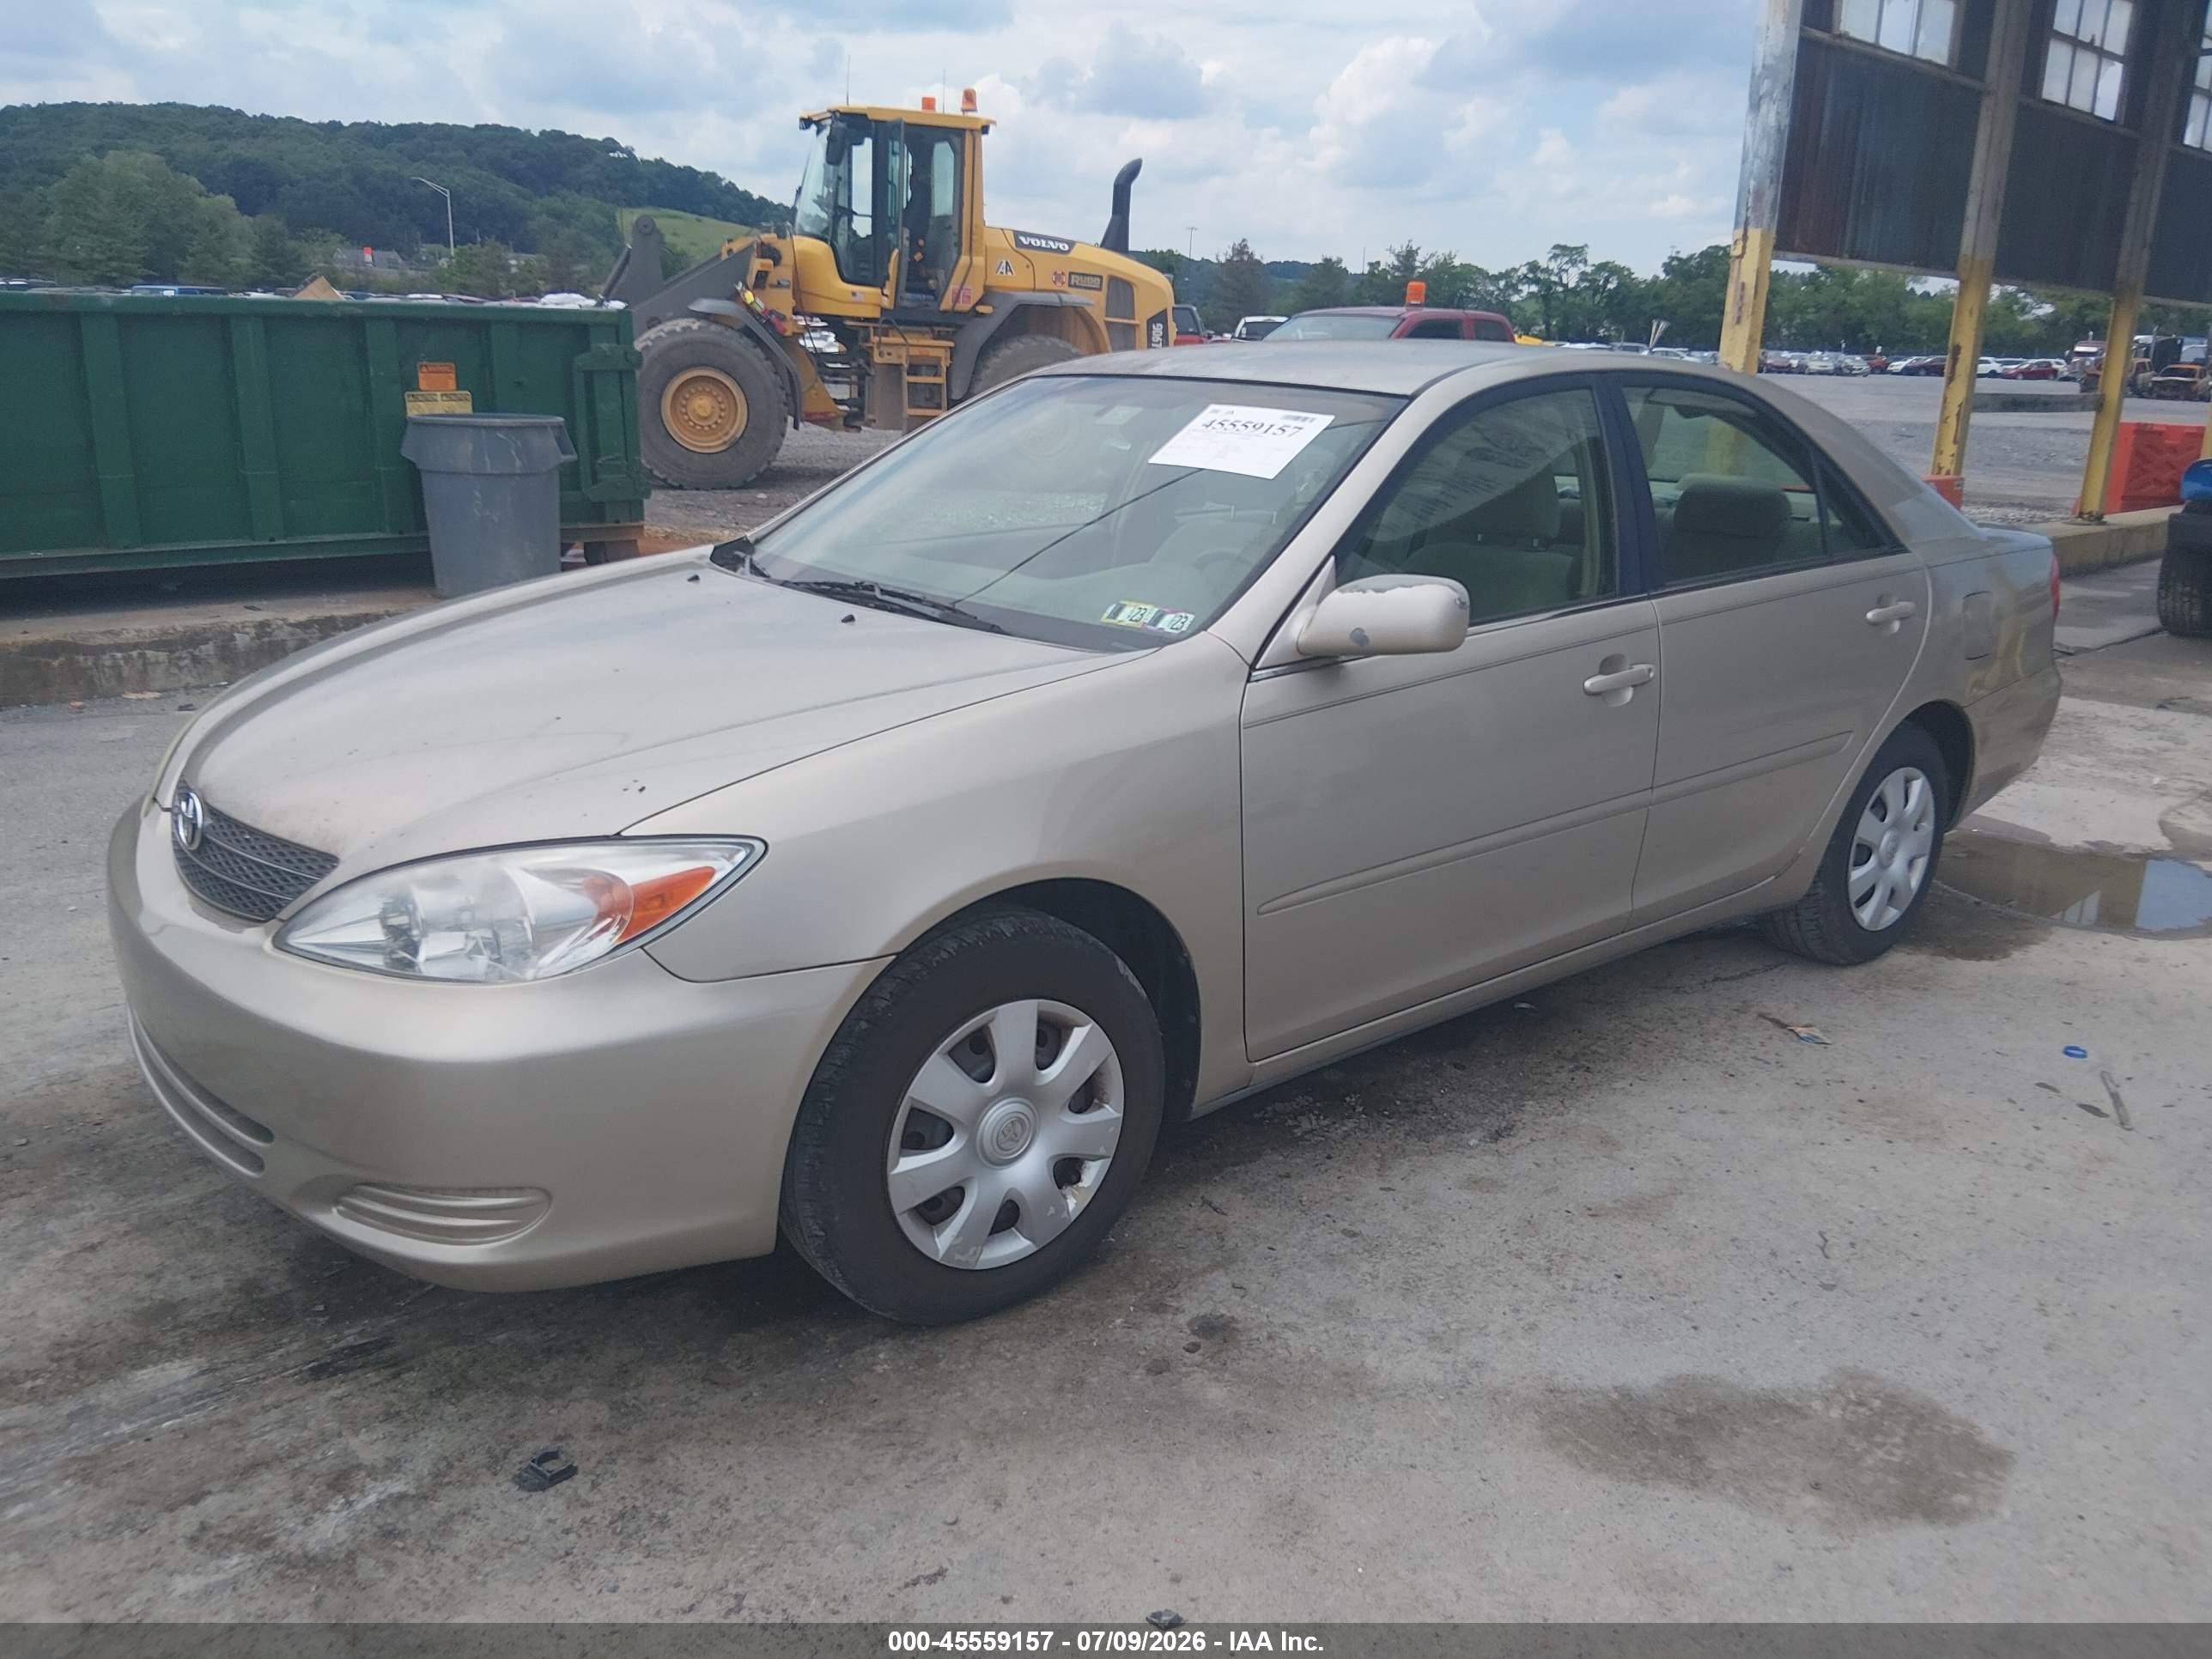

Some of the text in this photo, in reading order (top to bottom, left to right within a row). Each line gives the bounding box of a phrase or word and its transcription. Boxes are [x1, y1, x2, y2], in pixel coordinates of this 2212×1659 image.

[1018, 235, 1070, 252] VOLVO
[1203, 419, 1304, 437] 45559157
[1129, 606, 1148, 623] 23
[1170, 615, 1188, 631] 23
